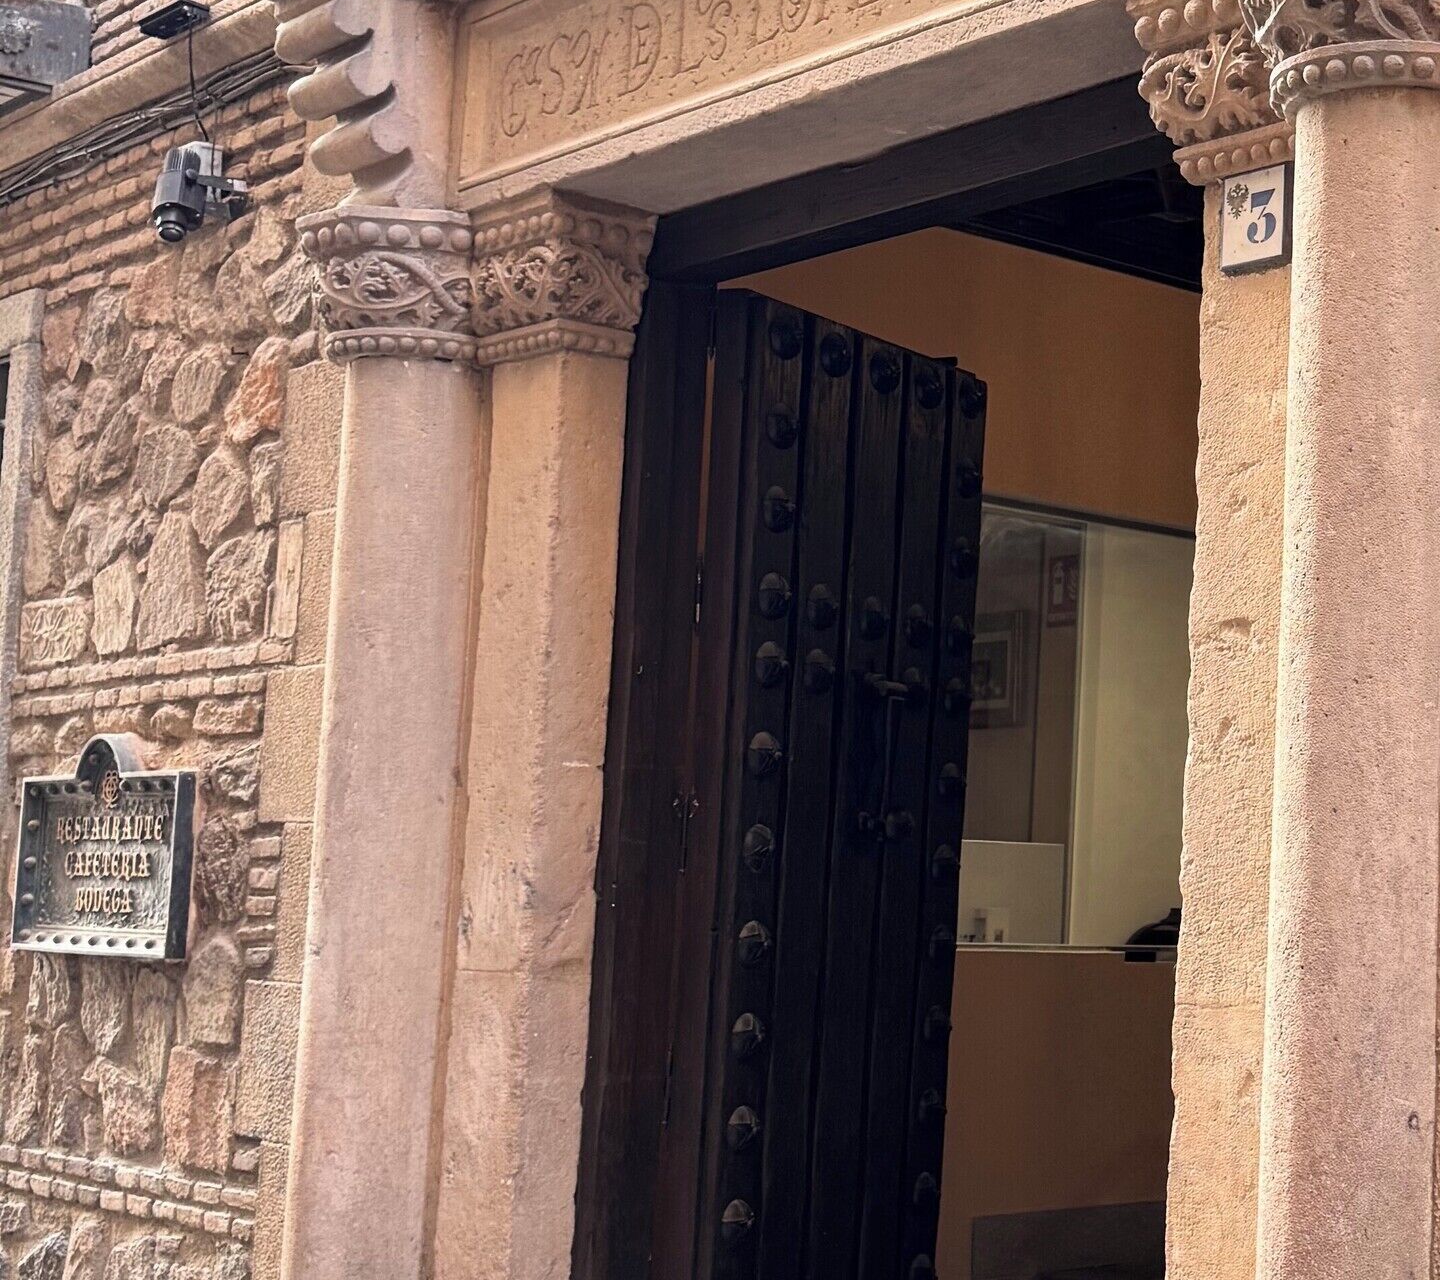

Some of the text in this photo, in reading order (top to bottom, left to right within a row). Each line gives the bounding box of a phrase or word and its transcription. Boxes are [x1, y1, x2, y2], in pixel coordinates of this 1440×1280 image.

[1246, 188, 1277, 244] 3
[56, 815, 164, 844] RESTAURANTE
[64, 851, 151, 880] CAFETERIA
[74, 887, 133, 915] BODEGA
